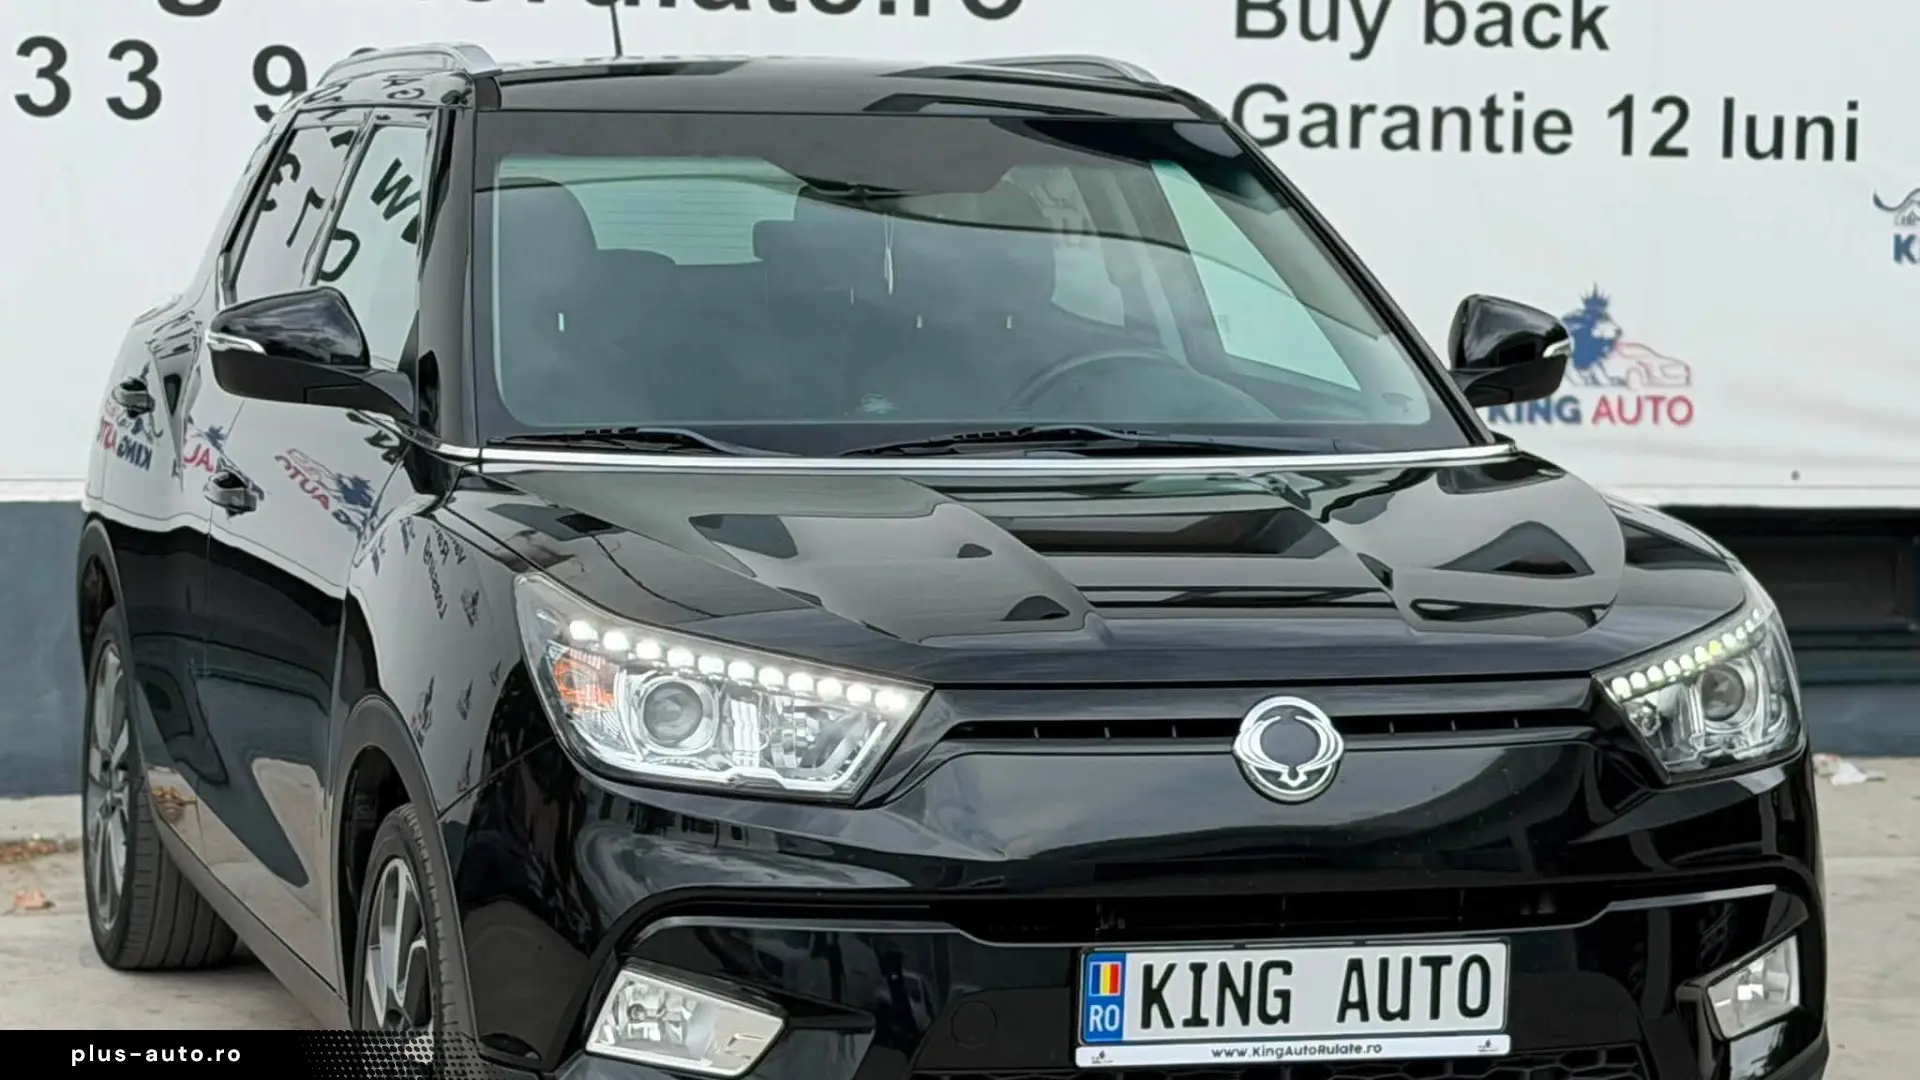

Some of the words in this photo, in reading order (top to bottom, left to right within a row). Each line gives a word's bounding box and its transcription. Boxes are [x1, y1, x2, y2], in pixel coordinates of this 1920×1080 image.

[1235, 0, 1392, 61] Buy
[1423, 0, 1610, 51] back
[1234, 83, 1573, 155] Garantie
[1606, 93, 1690, 159] 12
[1722, 97, 1859, 162] luni
[1591, 394, 1694, 426] AUTO
[1141, 960, 1293, 1030] KING
[1337, 954, 1491, 1023] AUTO
[1089, 1004, 1120, 1032] RO
[1211, 1043, 1383, 1060] www.KingAutoRulate.ro
